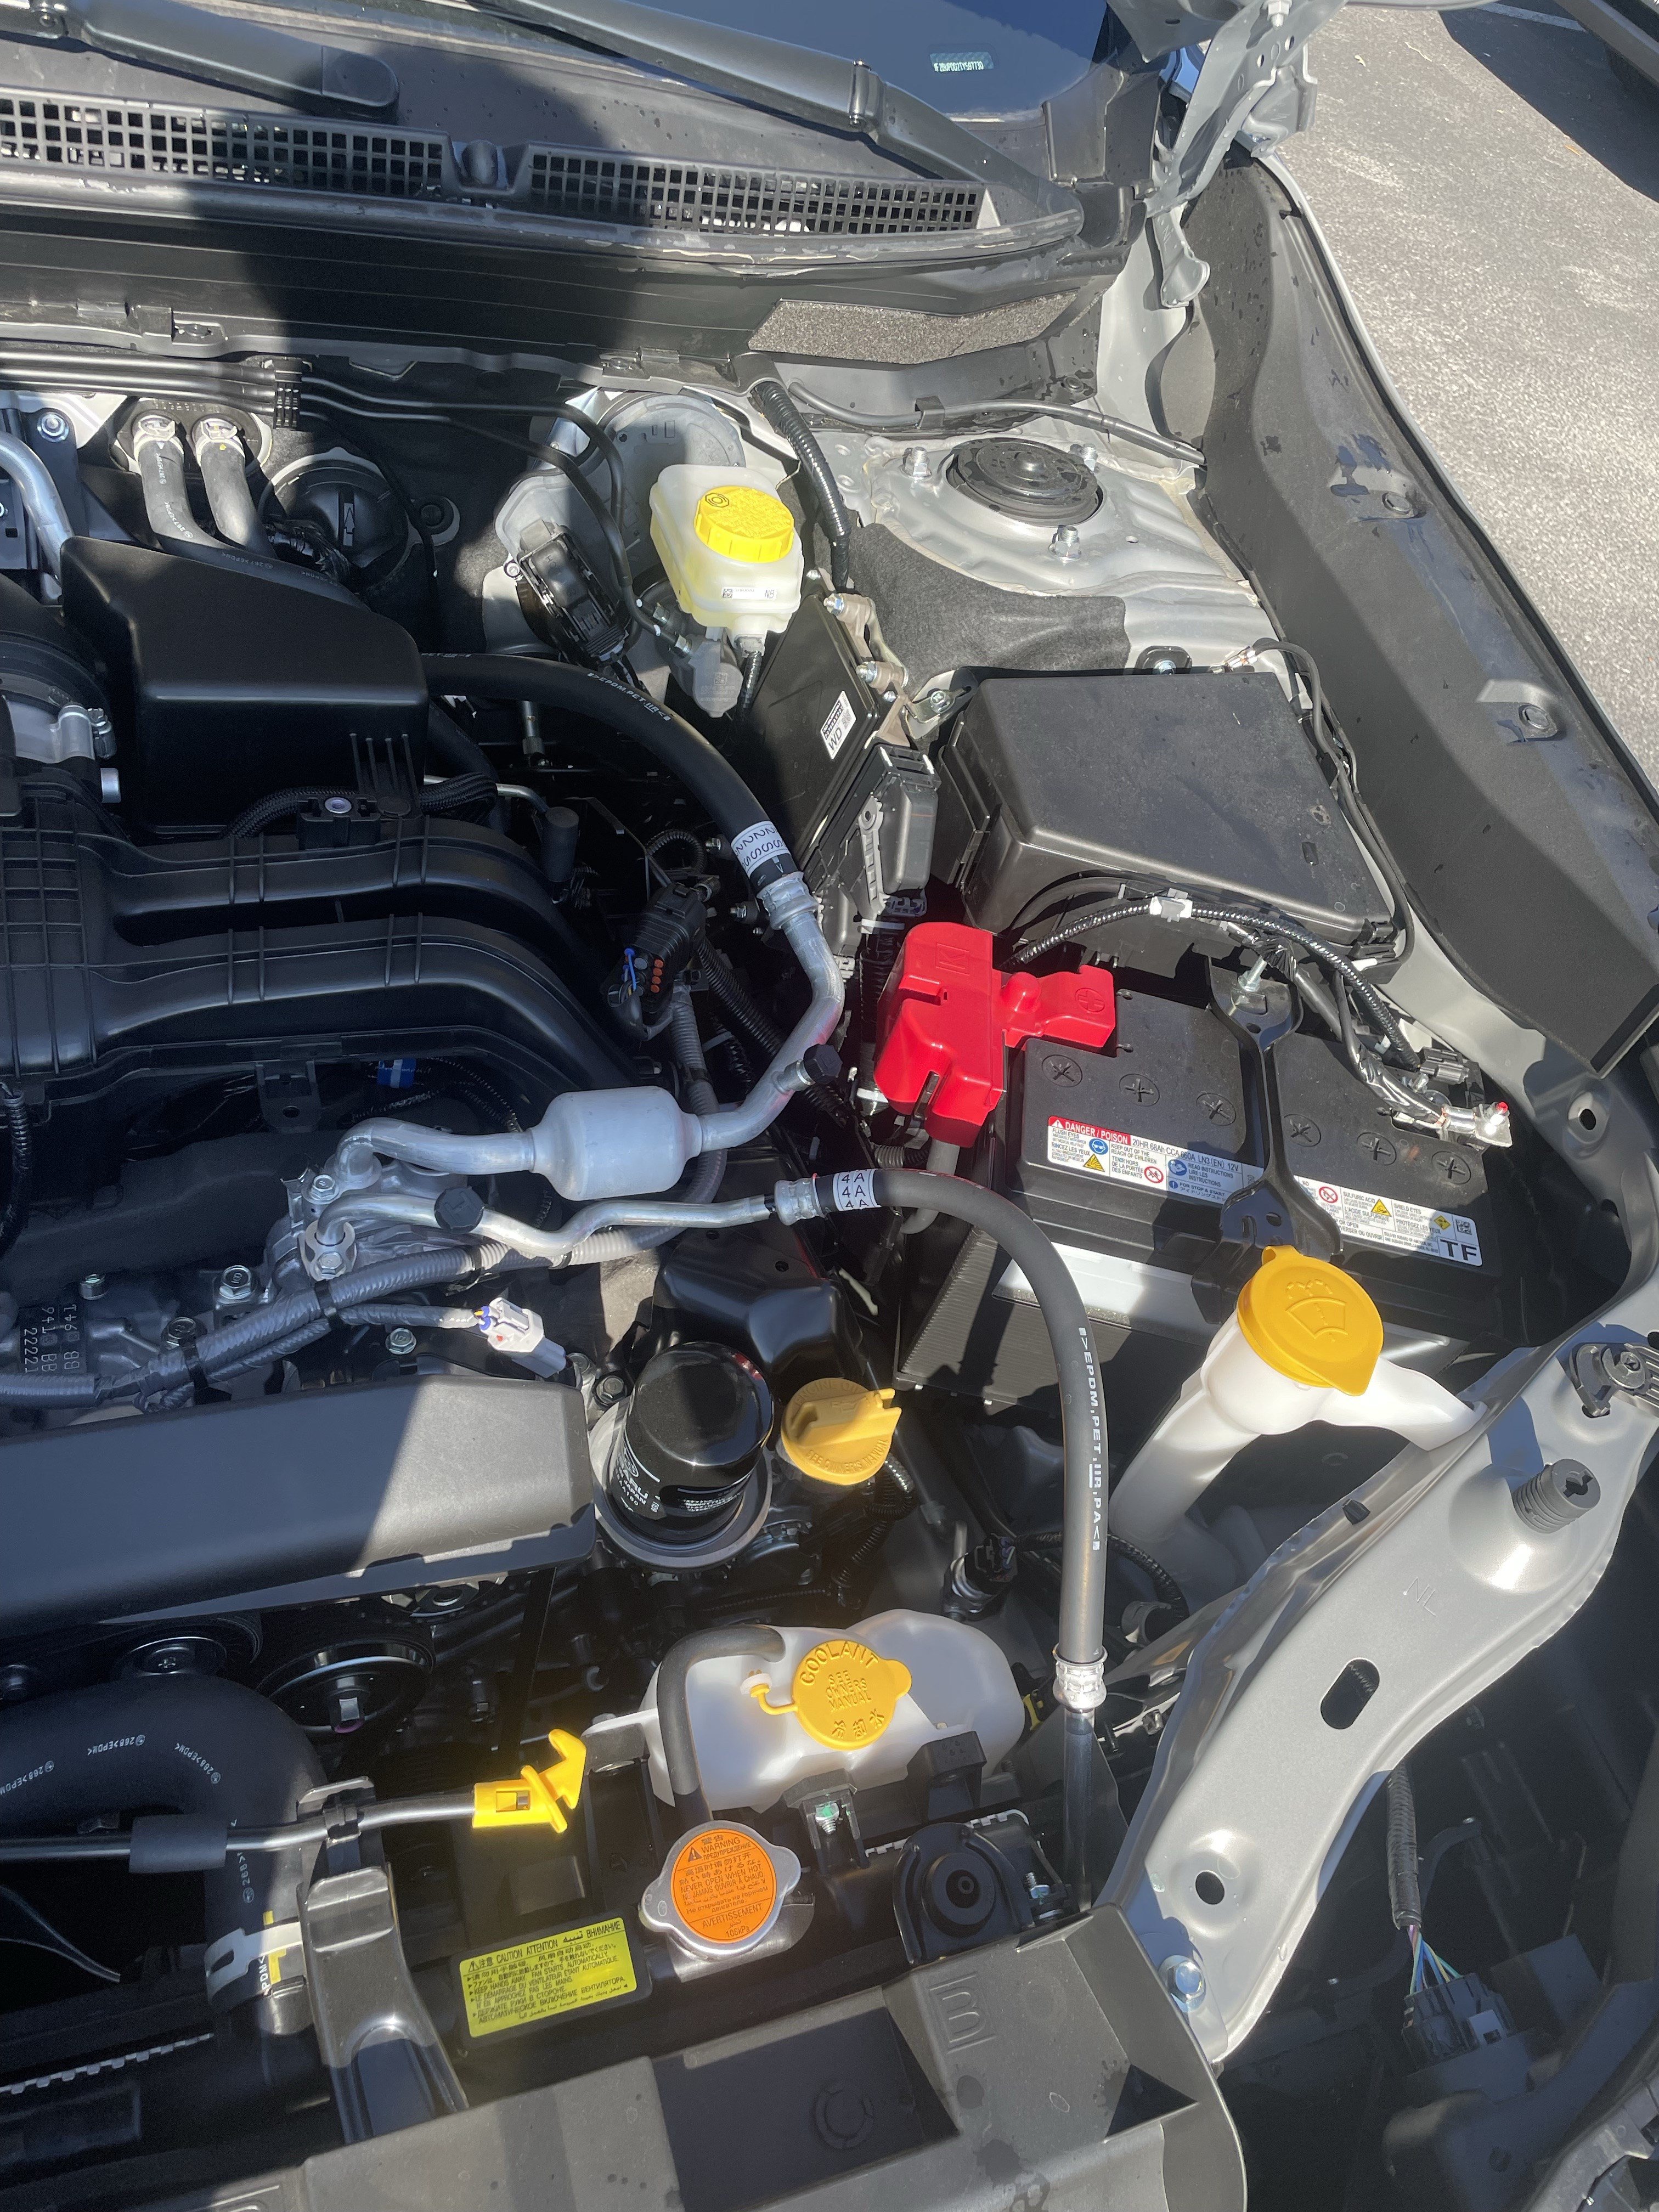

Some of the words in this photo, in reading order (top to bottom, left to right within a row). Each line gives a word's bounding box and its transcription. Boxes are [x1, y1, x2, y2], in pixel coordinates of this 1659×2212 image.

[765, 589, 774, 599] NB
[828, 727, 842, 751] WD
[1052, 1128, 1067, 1136] FLUSH
[1065, 1121, 1095, 1137] DANGER
[1101, 1130, 1128, 1144] POISON
[1078, 1148, 1090, 1156] YEUX
[1111, 1149, 1126, 1157] REACH
[1135, 1154, 1156, 1164] CHILDREN
[1132, 1138, 1149, 1149] 20HR
[1150, 1143, 1165, 1153] 68Ah
[1166, 1147, 1179, 1157] CCA
[1181, 1150, 1195, 1161] 660A
[1227, 1163, 1239, 1172] 12V
[1122, 1170, 1143, 1179] ENFANTS
[1126, 1164, 1143, 1173] PORTÉE
[1201, 1166, 1233, 1178] INSTRUCTIONS
[1189, 1175, 1221, 1187] INSTRUCTIONS
[1343, 1192, 1364, 1201] SULFURIC
[1396, 1218, 1419, 1229] PROTÉGEZ
[1366, 1232, 1383, 1240] OUVRIR
[1440, 1239, 1477, 1261] TF
[794, 1379, 836, 1406] ENGINE
[807, 1449, 824, 1465] SEE
[825, 1459, 864, 1474] OWNER'S
[862, 1439, 889, 1466] MANUAL
[800, 1641, 879, 1686] COOLANT
[828, 1670, 850, 1686] SEE
[825, 1678, 867, 1700] OWNERS
[828, 1690, 872, 1713] MANUAL
[701, 1837, 741, 1853] WARNING
[703, 1842, 751, 1860] ПРЕДУПРЕЖДЕНИЕ
[681, 1882, 703, 1893] NEVER
[706, 1876, 724, 1886] OPEN
[726, 1870, 746, 1881] WHEN
[693, 1886, 714, 1898] JAMAIS
[715, 1880, 737, 1891] OUVRIR
[702, 1903, 763, 1928] AVERTISSEMENT
[586, 1921, 621, 1938] ВНИМАНИЕ
[496, 1949, 523, 1963] CAUTION
[526, 1939, 558, 1956] ATTENTION
[474, 1985, 488, 1995] KEEP
[490, 1980, 509, 1990] HANDS
[531, 1970, 542, 1978] FAN
[544, 1963, 563, 1973] STARTS
[567, 1951, 608, 1968] AUTOMATICALLY
[519, 1982, 527, 1990] DU
[529, 1972, 562, 1986] VENTILATEUR
[494, 1989, 525, 2003] APPROCHEZ
[543, 1981, 552, 1990] LES
[555, 1976, 573, 1986] MAINS
[536, 1986, 566, 2000] СТОРОНЕ
